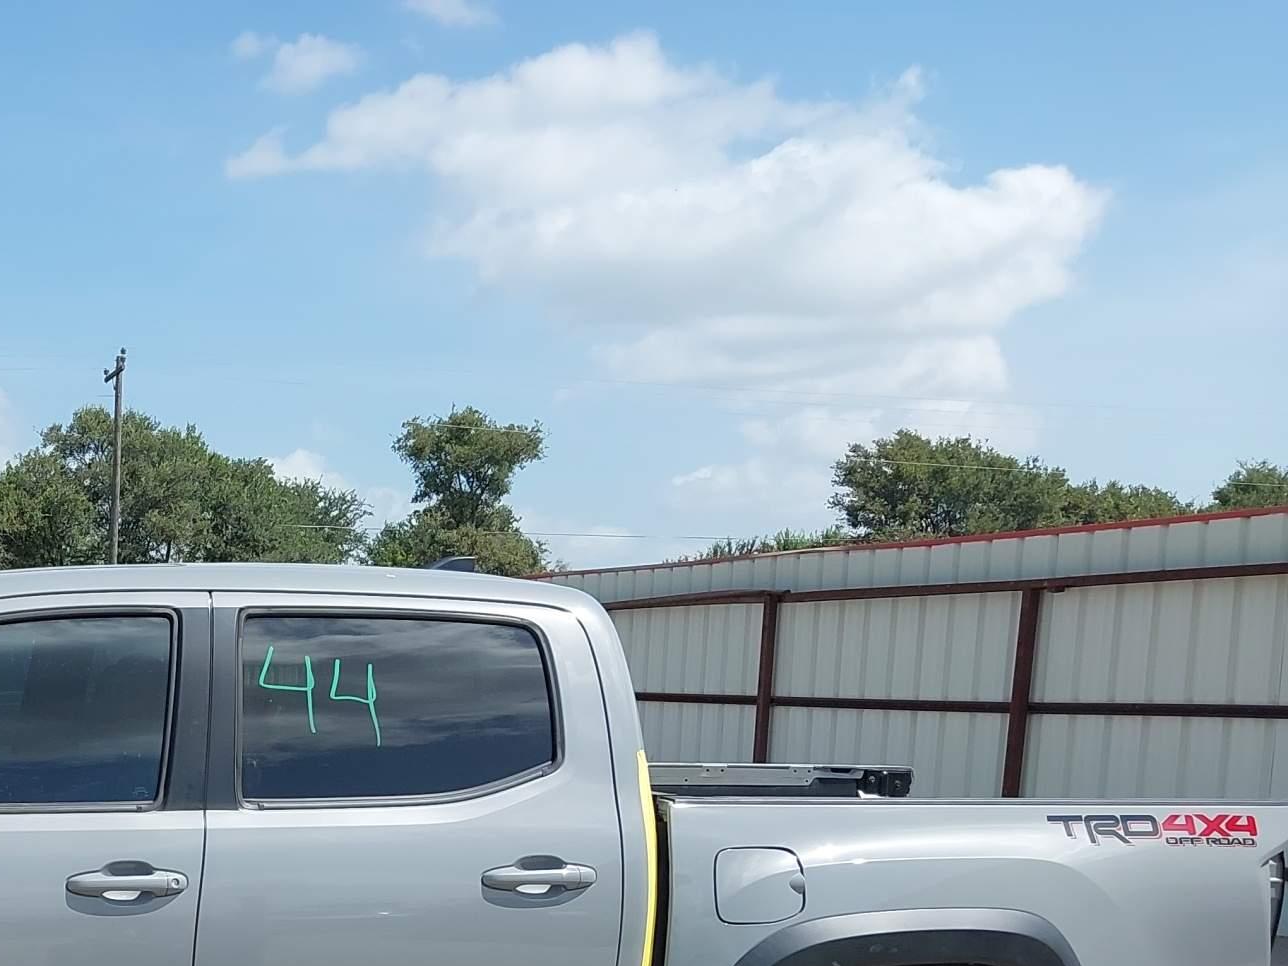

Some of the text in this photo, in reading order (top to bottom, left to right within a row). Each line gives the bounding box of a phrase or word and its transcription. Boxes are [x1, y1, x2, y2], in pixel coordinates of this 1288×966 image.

[259, 646, 379, 746] 44
[1046, 814, 1258, 846] TRD 4X4
[1165, 837, 1256, 846] OFF ROAD
